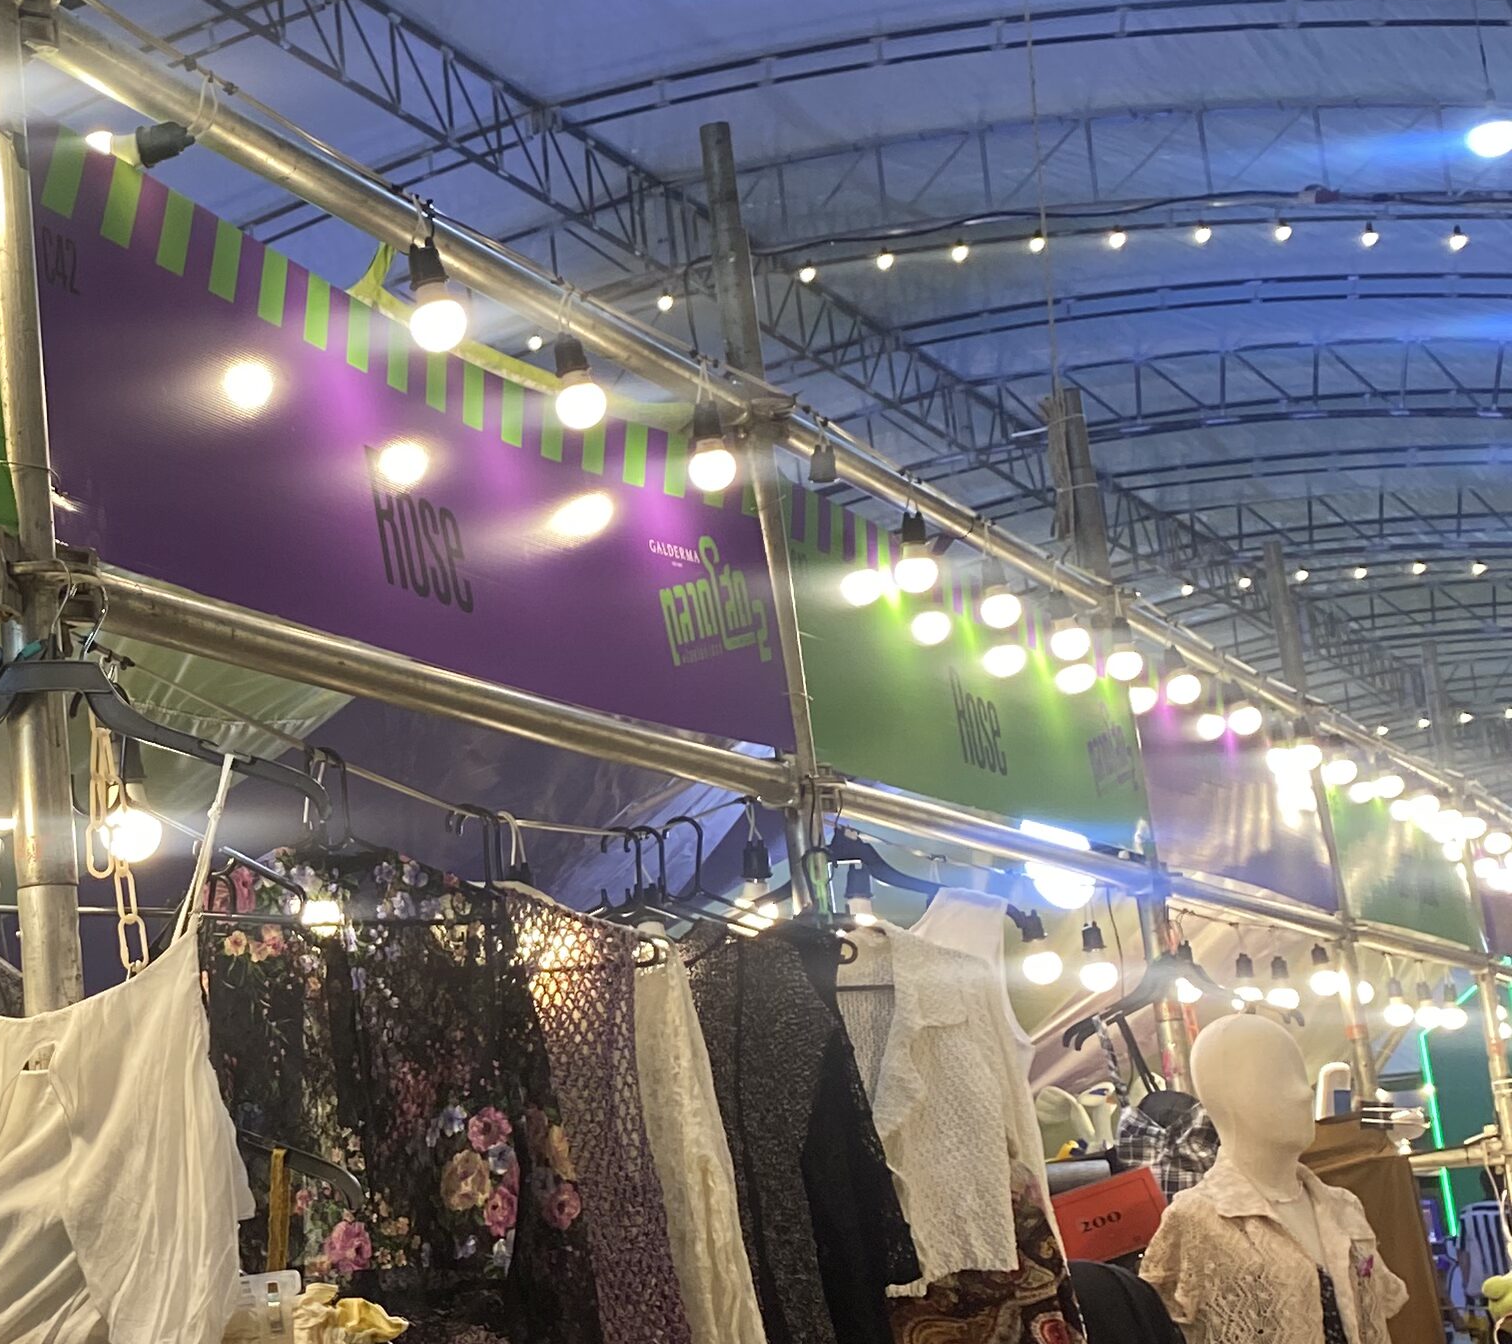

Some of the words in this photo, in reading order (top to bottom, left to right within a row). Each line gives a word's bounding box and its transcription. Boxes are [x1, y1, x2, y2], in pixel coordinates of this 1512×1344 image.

[648, 539, 701, 564] GALDERMA
[948, 665, 1008, 776] Rose
[1081, 1211, 1122, 1233] 200
